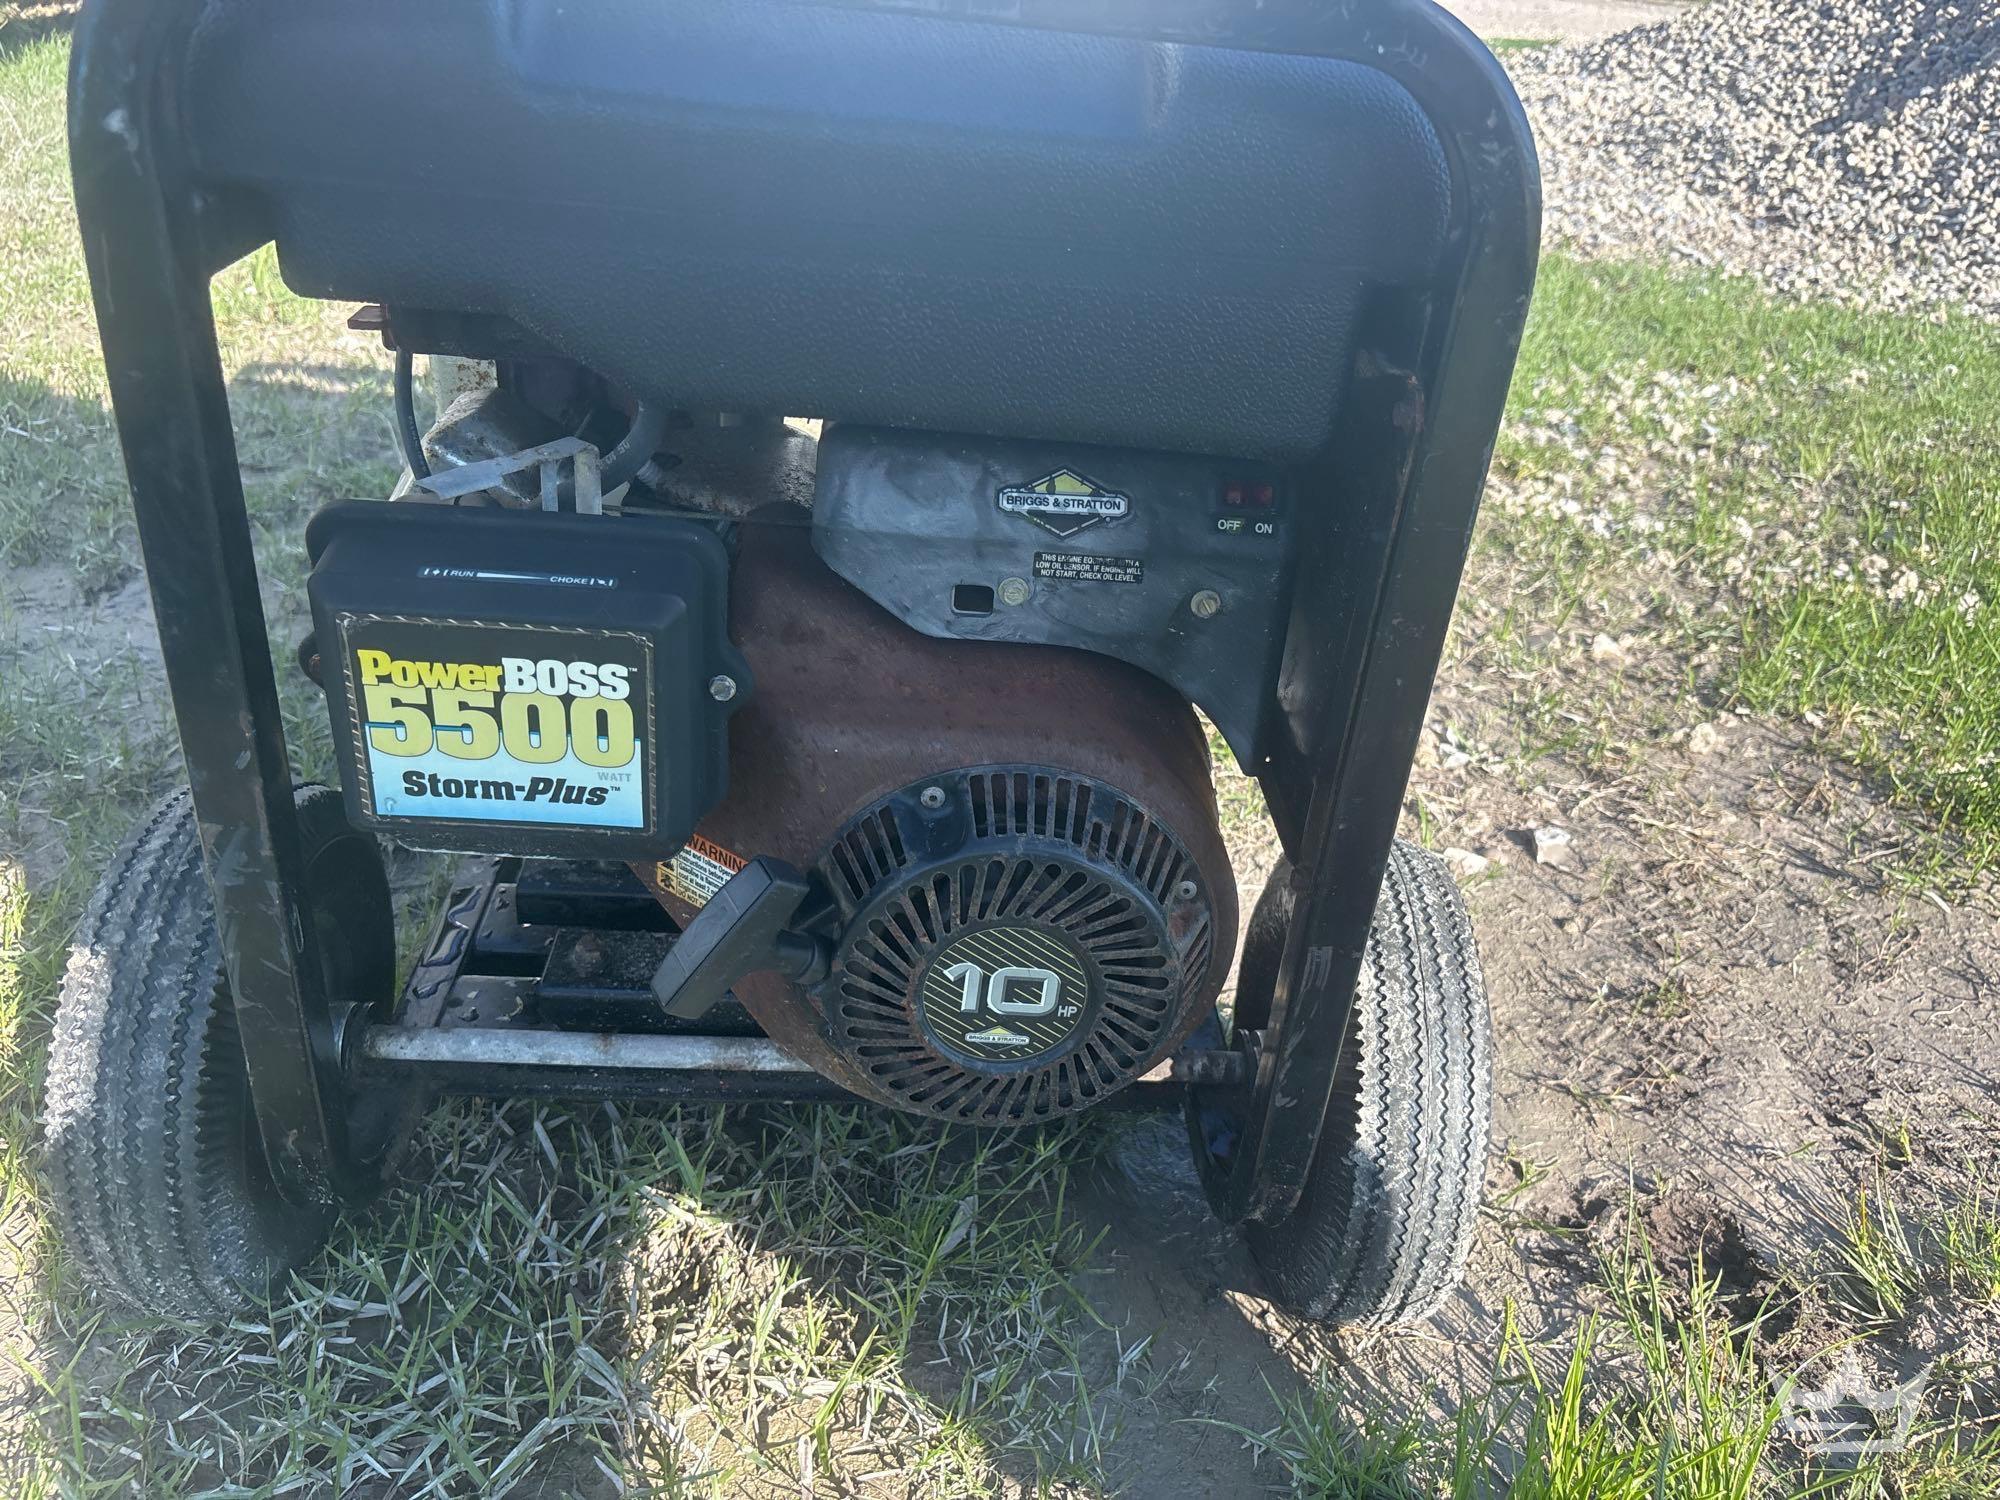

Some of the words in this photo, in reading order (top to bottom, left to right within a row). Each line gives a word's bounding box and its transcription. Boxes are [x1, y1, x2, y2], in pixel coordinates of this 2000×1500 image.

[1006, 495, 1050, 508] BRIGGS
[1052, 497, 1060, 508] &
[1062, 497, 1121, 511] STRATTON
[1217, 519, 1242, 532] OFF
[1254, 523, 1273, 534] ON
[1042, 553, 1056, 562] THIS
[1035, 561, 1051, 569] LOW
[1051, 562, 1062, 570] OIL
[1126, 567, 1142, 575] WILL
[1040, 568, 1054, 577] NOT
[1055, 569, 1078, 579] START,
[1079, 571, 1102, 580] CHECK
[1102, 572, 1113, 581] OIL
[449, 570, 475, 578] RUN
[550, 575, 588, 585] CHOKE
[357, 649, 630, 700] PowerBOSS
[364, 684, 636, 768] 5500
[597, 771, 632, 783] WATT
[402, 769, 609, 806] Storm-Plus
[689, 835, 744, 871] WARNIN
[943, 962, 1062, 1017] 10
[1057, 1005, 1078, 1018] HP
